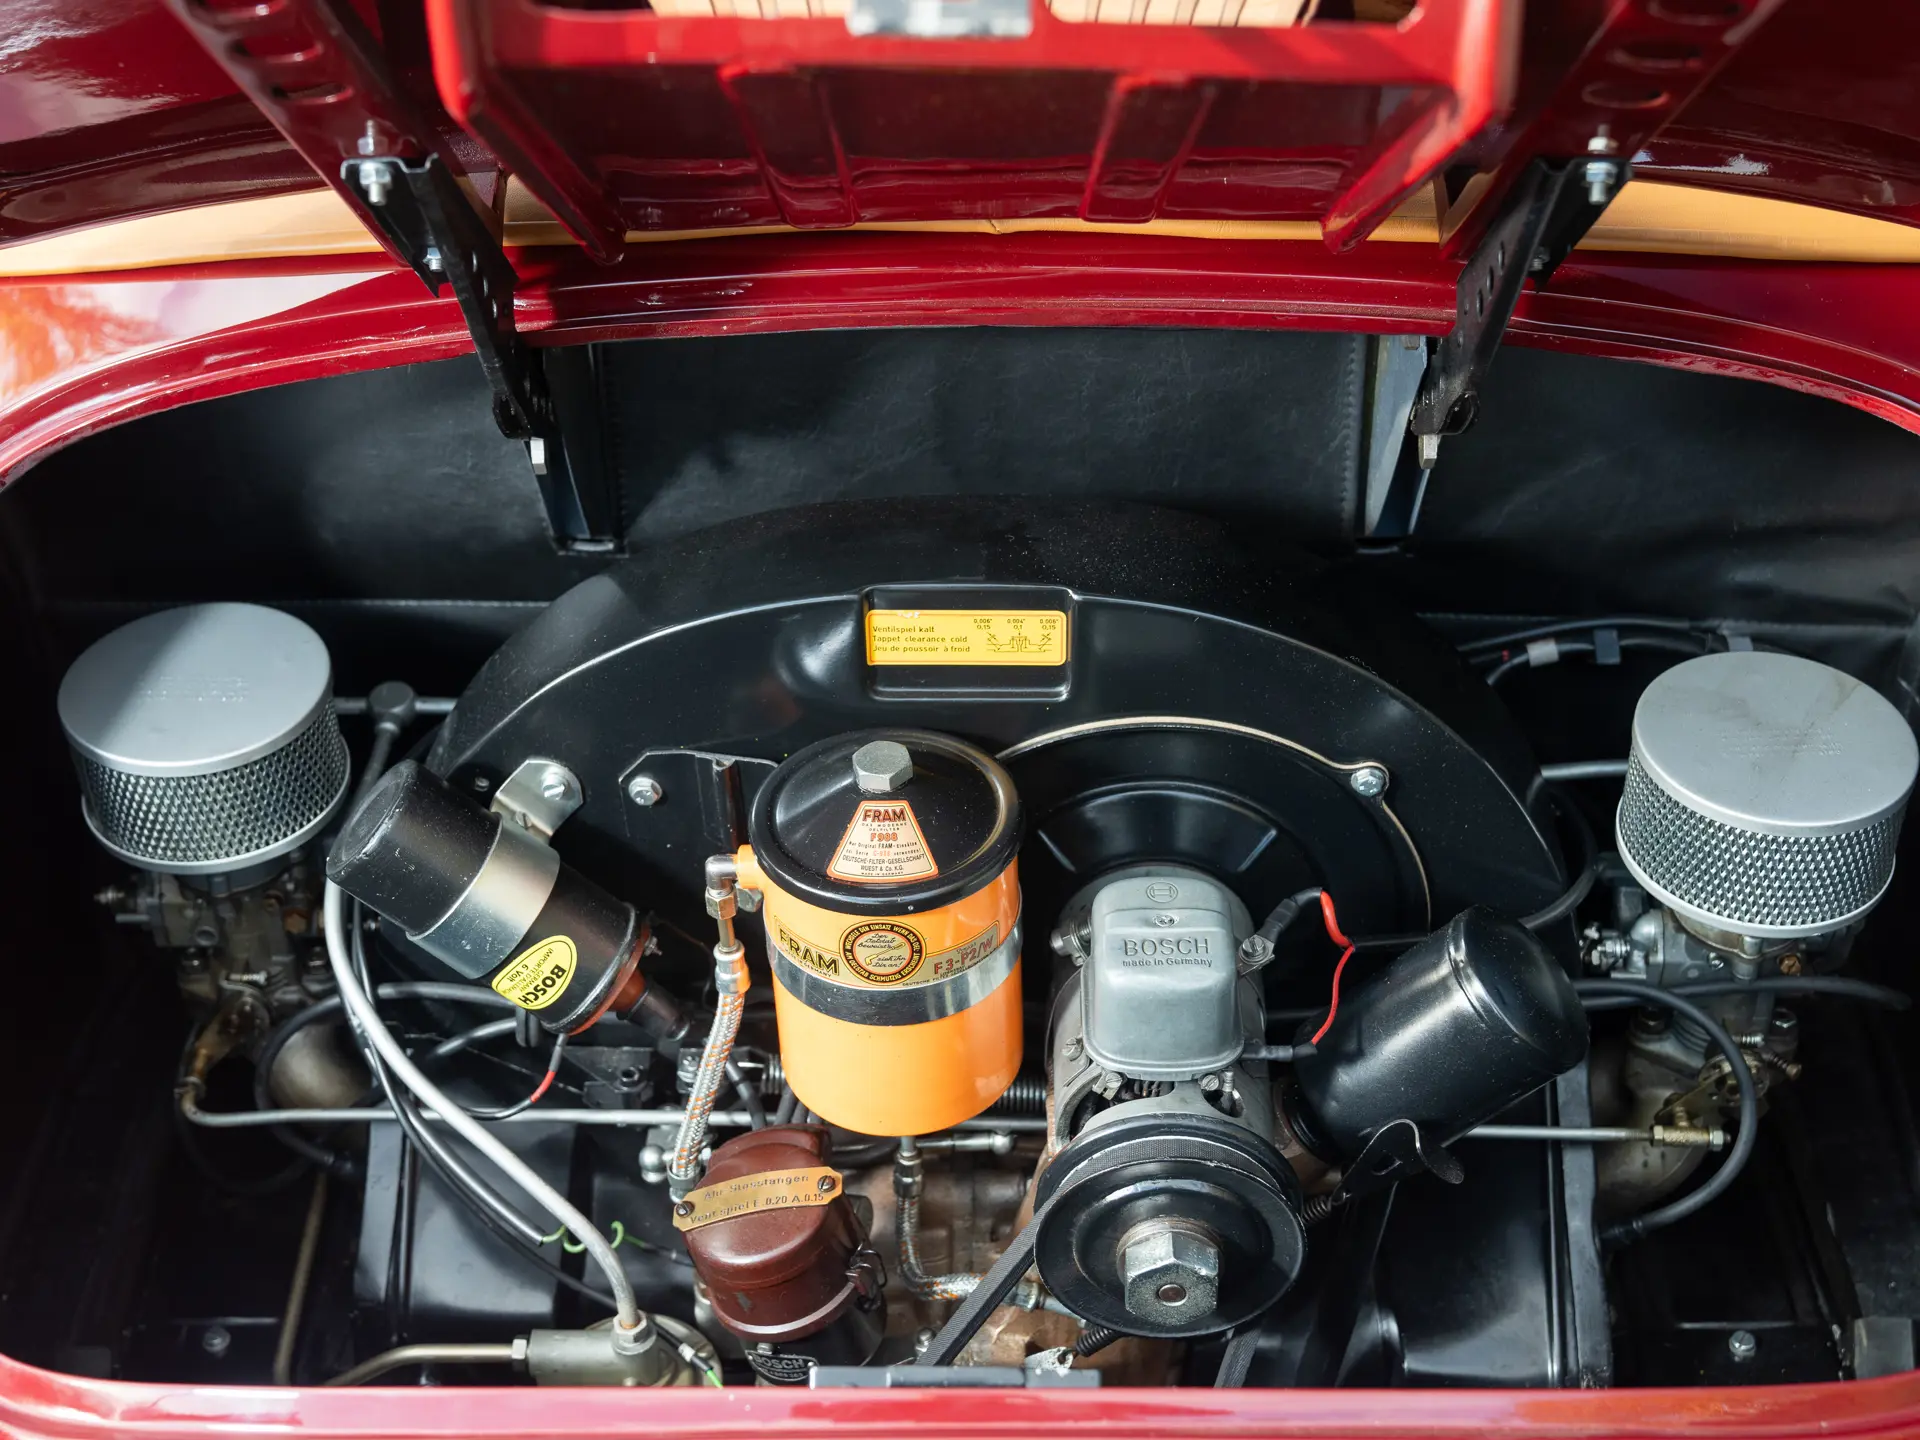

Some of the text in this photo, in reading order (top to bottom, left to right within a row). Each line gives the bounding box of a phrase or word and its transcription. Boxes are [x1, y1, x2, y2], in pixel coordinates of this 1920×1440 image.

[872, 626, 916, 634] Ventilspiel
[862, 808, 907, 822] FRAM
[779, 927, 839, 977] FRAM
[1123, 936, 1210, 957] BOSCH
[530, 948, 554, 976] IMPORTE
[1122, 957, 1213, 968] made in Germany
[506, 963, 529, 982] 6 Volt
[520, 970, 544, 992] GERMANY
[869, 973, 902, 982] SCHMUTZIG
[517, 964, 567, 1006] BOSCH
[753, 1353, 805, 1369] BOSCH
